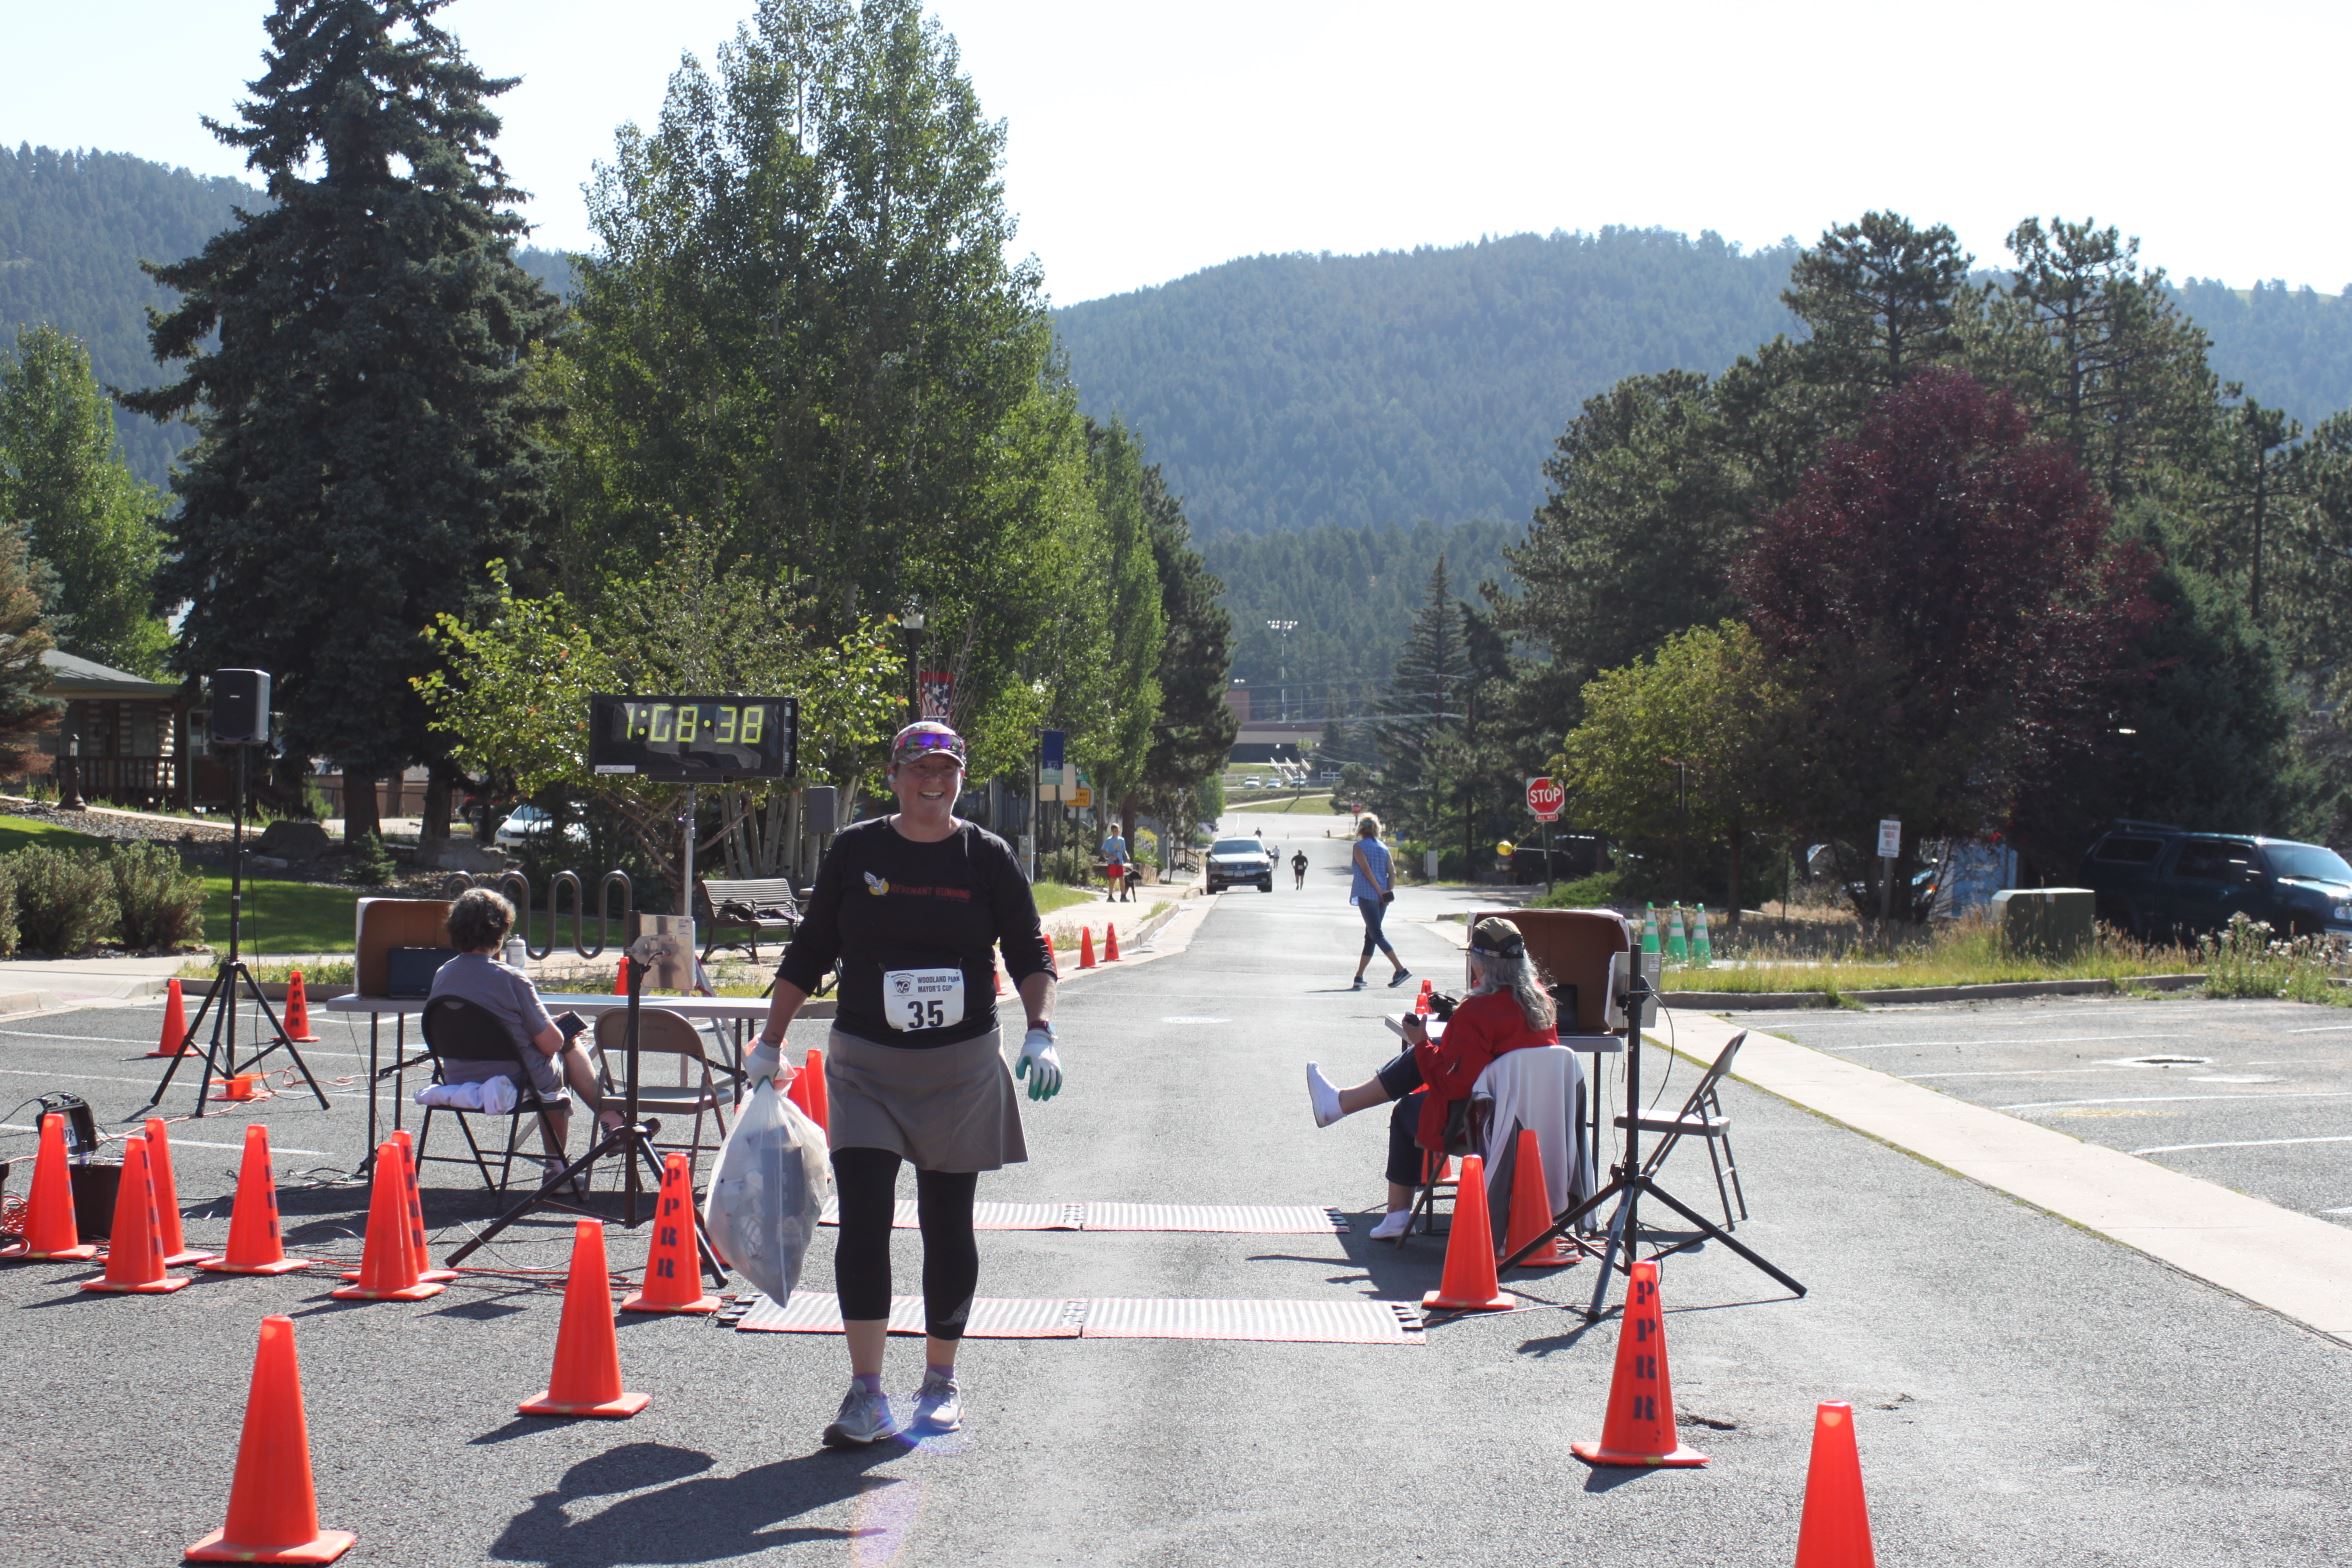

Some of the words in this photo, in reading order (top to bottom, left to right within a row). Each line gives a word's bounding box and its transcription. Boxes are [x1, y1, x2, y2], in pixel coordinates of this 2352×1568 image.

[1530, 787, 1561, 803] STOP
[917, 985, 941, 993] MAYOR'S
[942, 984, 953, 992] CUP
[907, 1000, 944, 1028] 35
[657, 1168, 681, 1278] PPRR
[1633, 1281, 1656, 1421] PPRR
